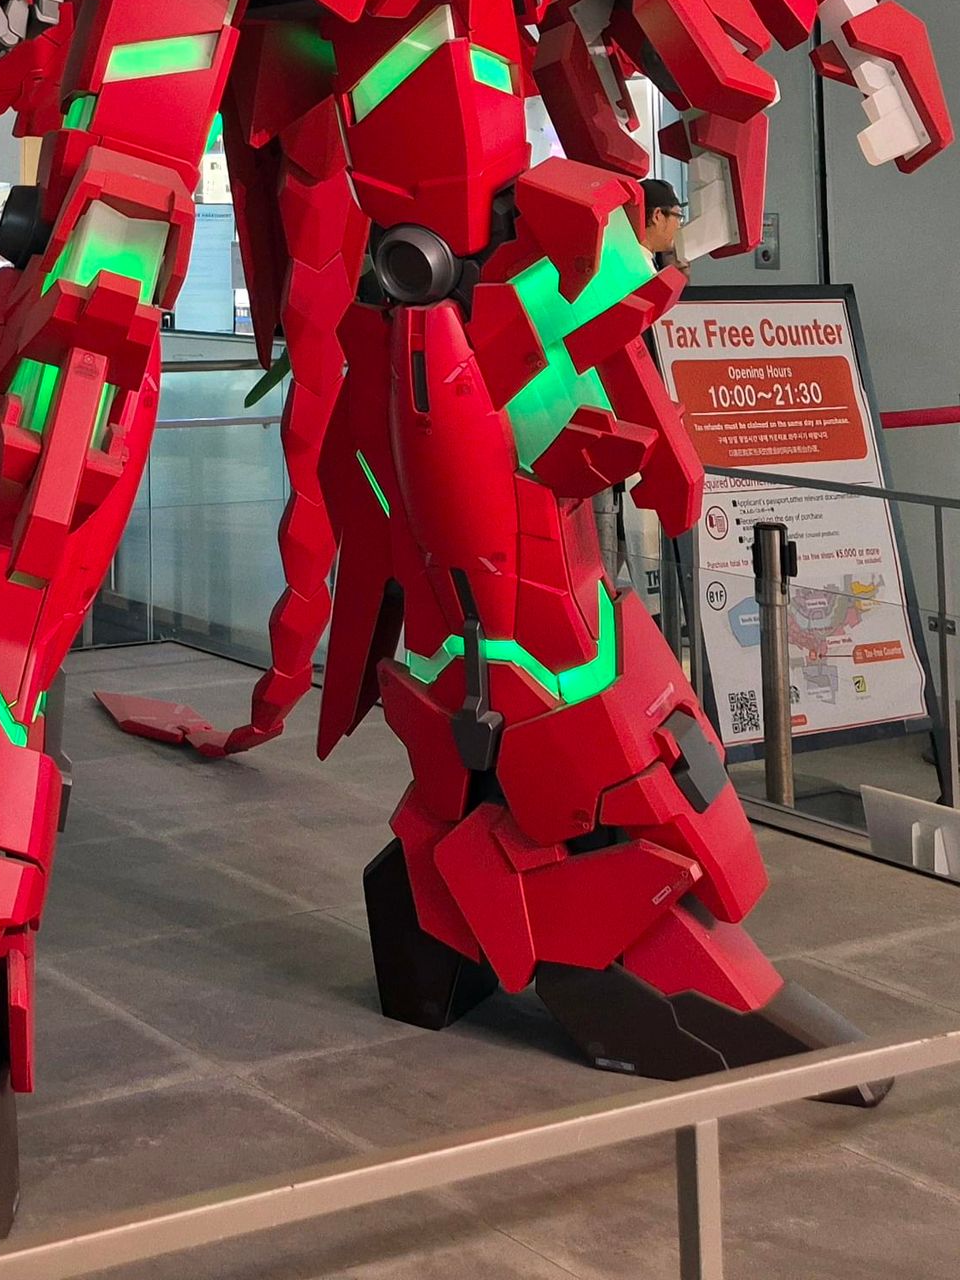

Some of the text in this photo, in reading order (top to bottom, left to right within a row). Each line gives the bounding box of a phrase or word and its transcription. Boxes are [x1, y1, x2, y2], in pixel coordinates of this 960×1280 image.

[661, 318, 843, 349] Tax Free Counter
[728, 364, 793, 380] Opening Hours
[703, 477, 728, 491] equired
[865, 548, 880, 556] more
[708, 589, 725, 604] B1F
